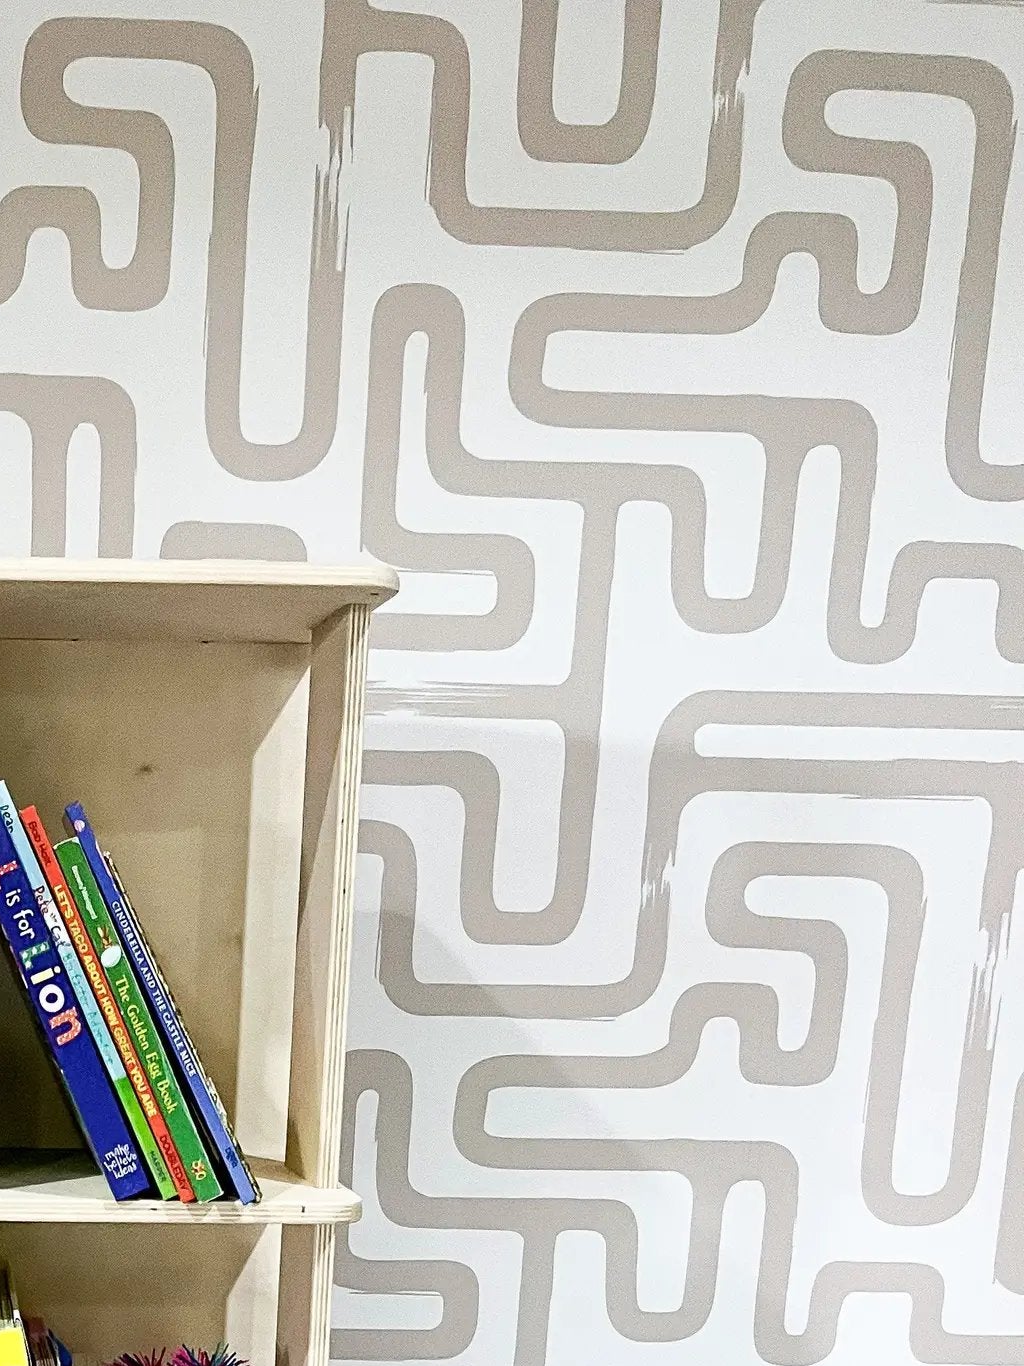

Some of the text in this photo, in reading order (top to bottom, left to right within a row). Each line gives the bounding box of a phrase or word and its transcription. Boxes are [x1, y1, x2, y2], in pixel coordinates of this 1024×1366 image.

[0, 803, 16, 833] Dean
[5, 888, 21, 907] is
[32, 885, 51, 914] Pete
[49, 924, 68, 949] Cat
[13, 909, 35, 939] for
[19, 941, 82, 1046] Lion
[109, 900, 198, 1077] CINDERELLA AND THE CASTLE NICE
[68, 919, 90, 954] TACO
[82, 953, 108, 997] ABOUT
[99, 996, 121, 1028] HOW
[112, 1026, 137, 1066] GREAT
[129, 1066, 148, 1093] YOU
[140, 1091, 158, 1118] ARE
[113, 974, 180, 1114] The Golden Egg Book
[104, 1153, 137, 1173] believe
[105, 1143, 130, 1161] make
[113, 1163, 137, 1179] ideas
[160, 1135, 187, 1190] DOUBLEDAY
